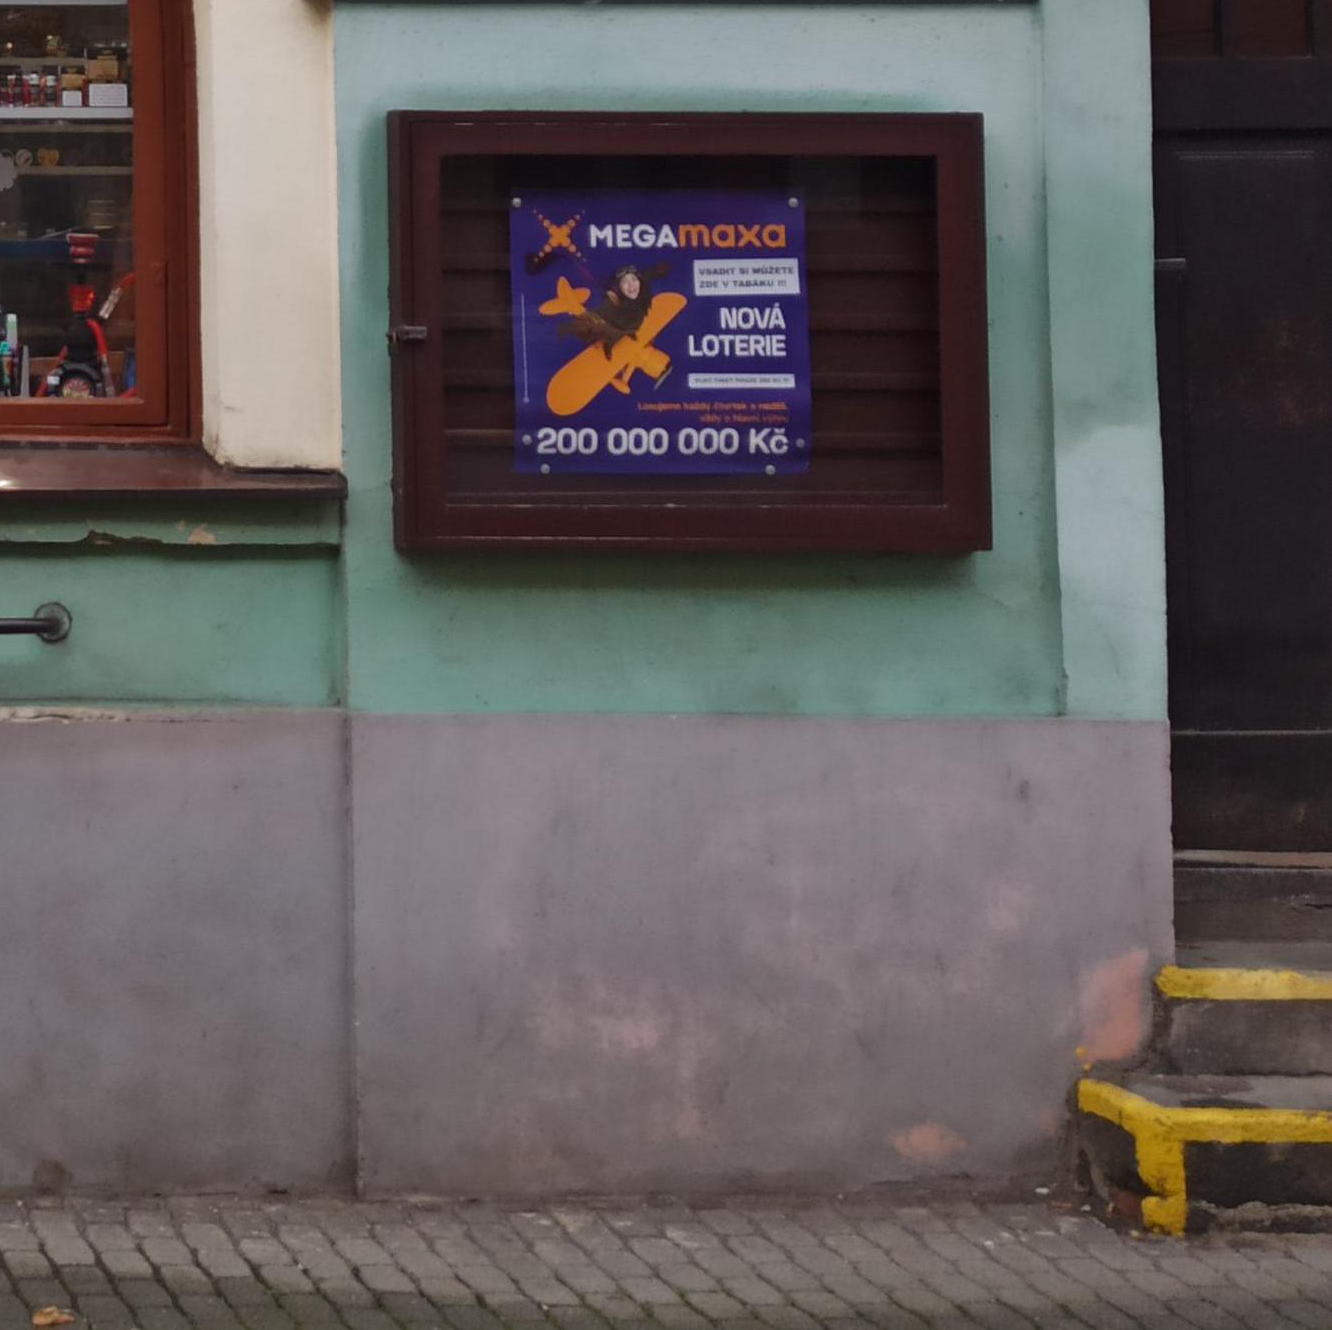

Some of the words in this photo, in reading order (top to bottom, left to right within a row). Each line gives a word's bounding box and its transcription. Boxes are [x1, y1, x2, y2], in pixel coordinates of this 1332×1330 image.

[698, 267, 735, 276] VSADIT
[699, 280, 718, 288] ZDE
[722, 280, 729, 288] V
[719, 302, 786, 330] NOVÁ
[688, 334, 787, 357] LOTERIE
[537, 427, 598, 455] 200
[607, 427, 669, 455] 000
[678, 427, 739, 455] 000
[749, 427, 789, 455] Kč
